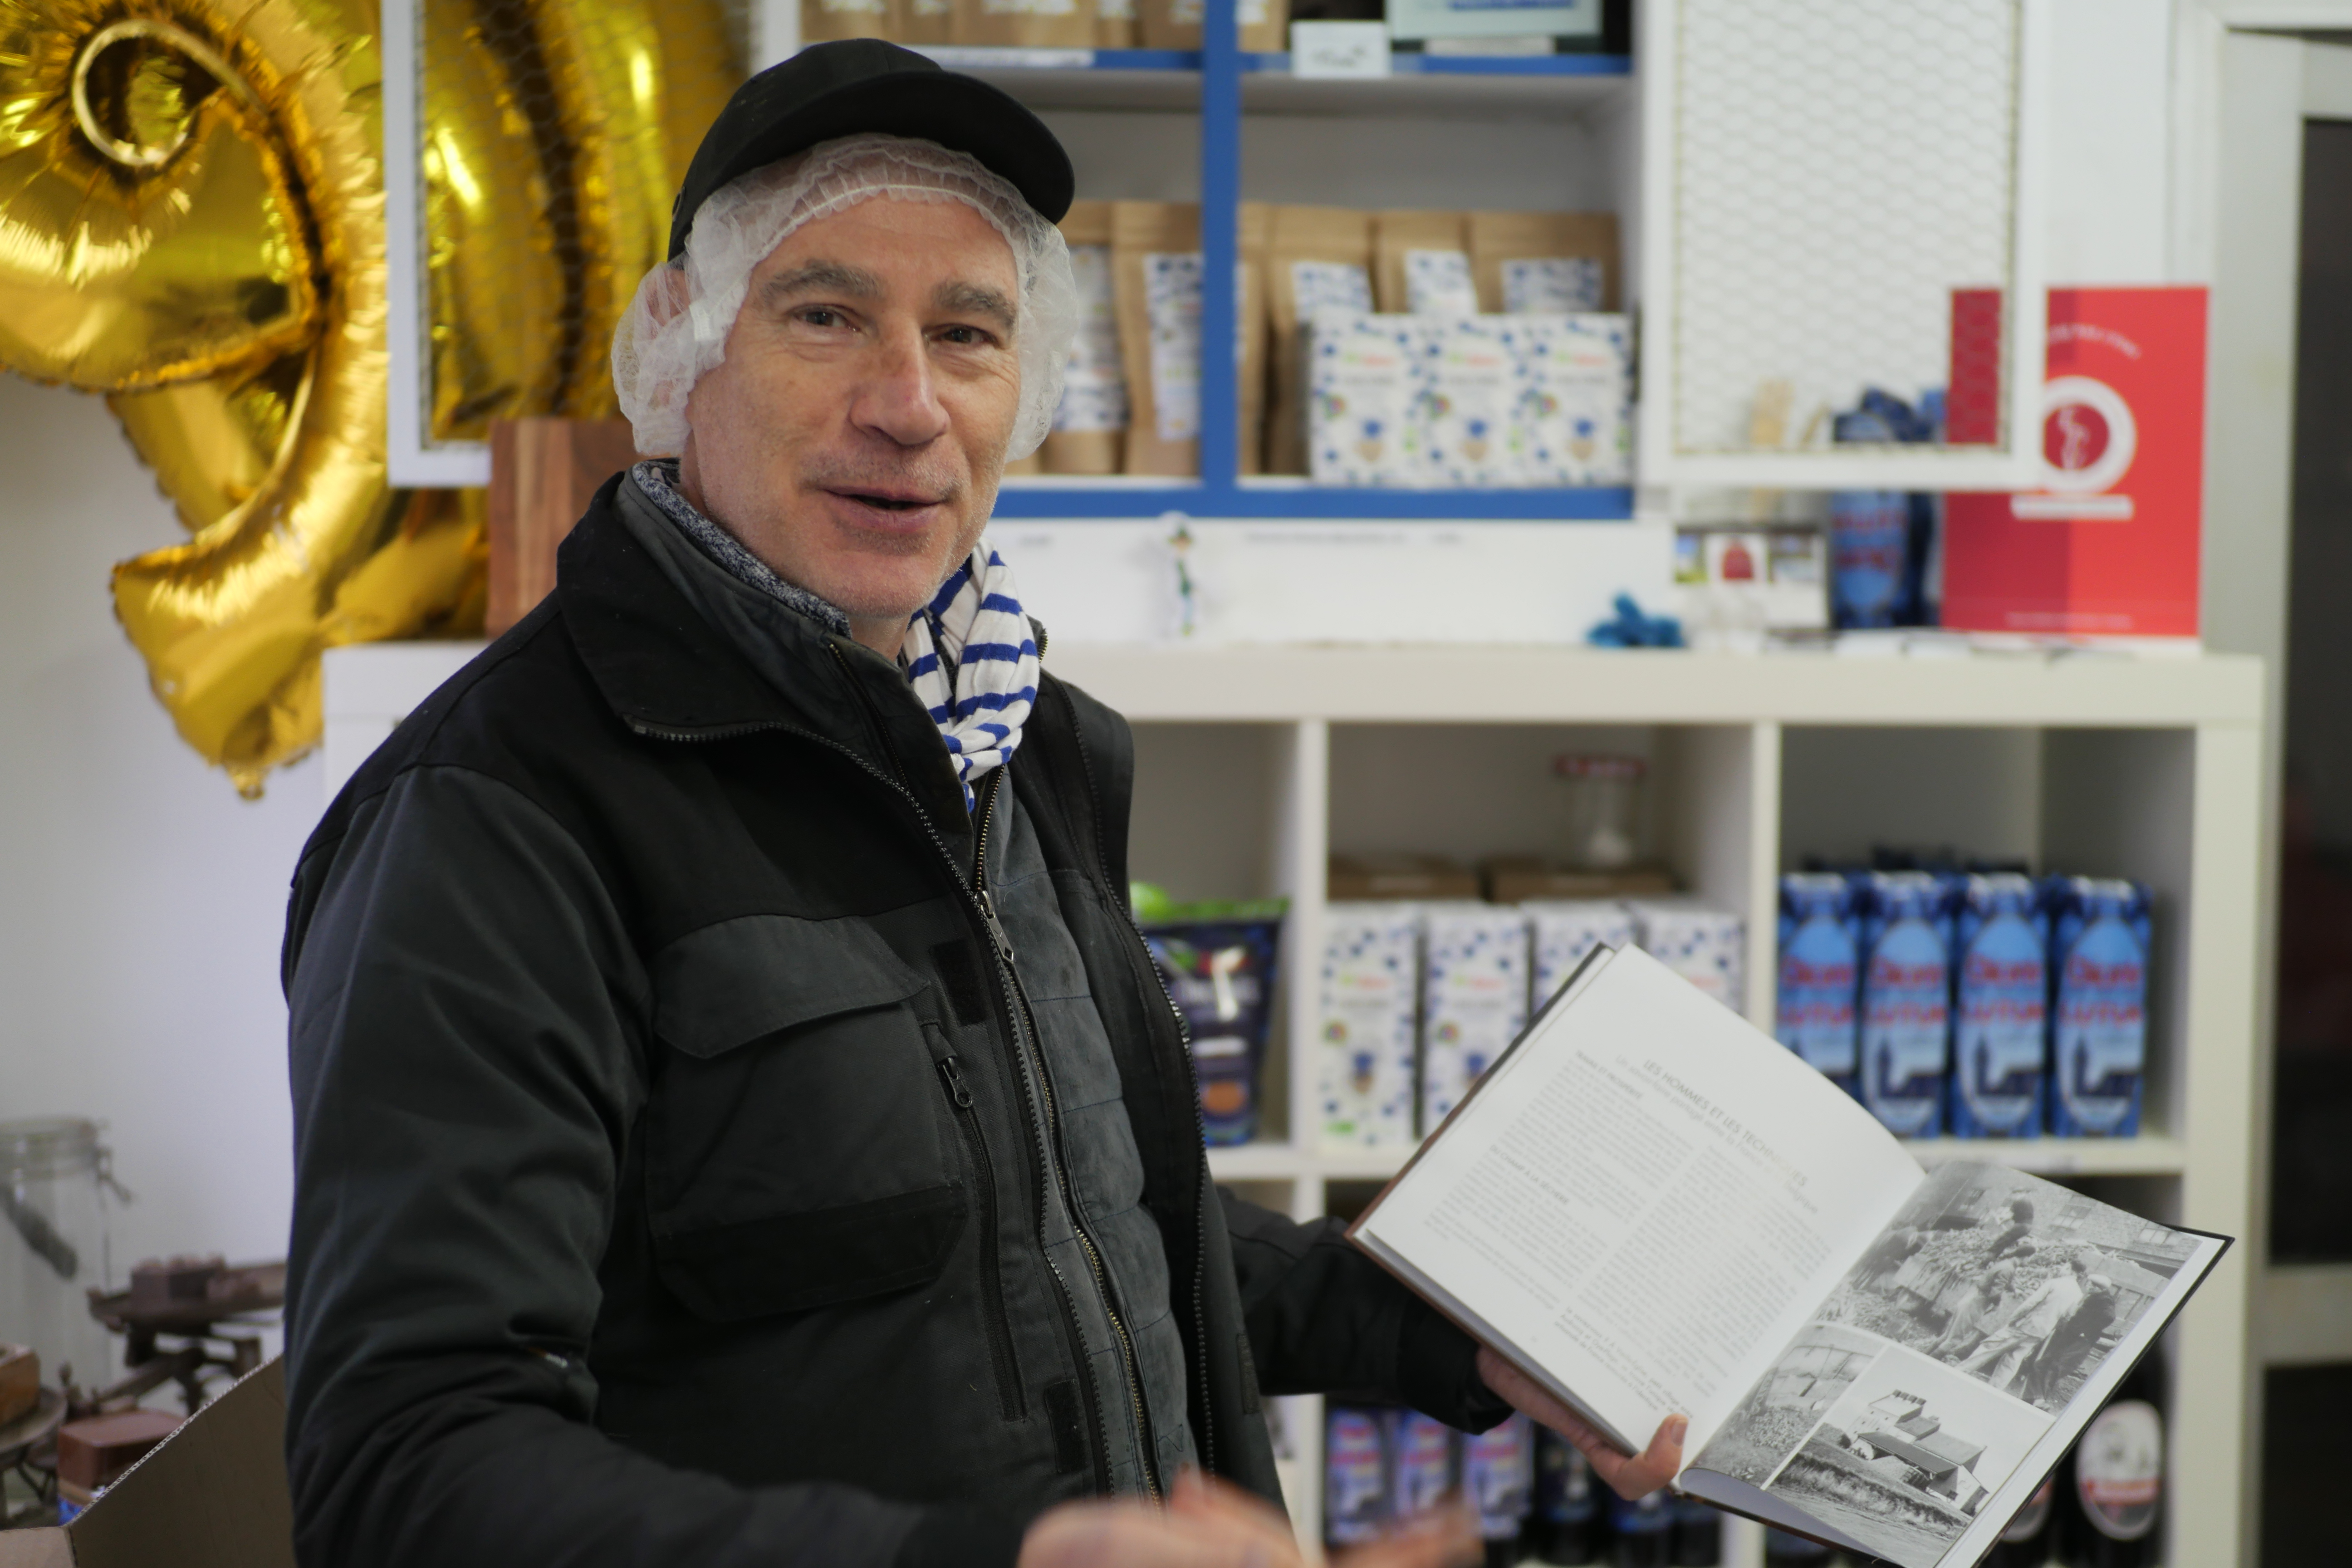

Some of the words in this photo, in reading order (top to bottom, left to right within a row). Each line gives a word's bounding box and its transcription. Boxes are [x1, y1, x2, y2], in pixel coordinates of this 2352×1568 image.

[1574, 1049, 1598, 1069] TRAVAIL
[1597, 1066, 1607, 1075] ET
[1606, 1072, 1643, 1100] PROSPÉRITÉ
[1642, 1059, 1662, 1076] LES
[1661, 1072, 1710, 1110] HOMMES
[1709, 1106, 1724, 1120] ET
[1722, 1116, 1742, 1134] LES
[1740, 1130, 1808, 1186] TECHNIQUES
[1489, 1144, 1501, 1155] DU
[1499, 1152, 1525, 1173] CHAMP
[1523, 1168, 1532, 1177] À
[1529, 1174, 1540, 1184] LA
[1539, 1180, 1570, 1205] SÉCHERIE
